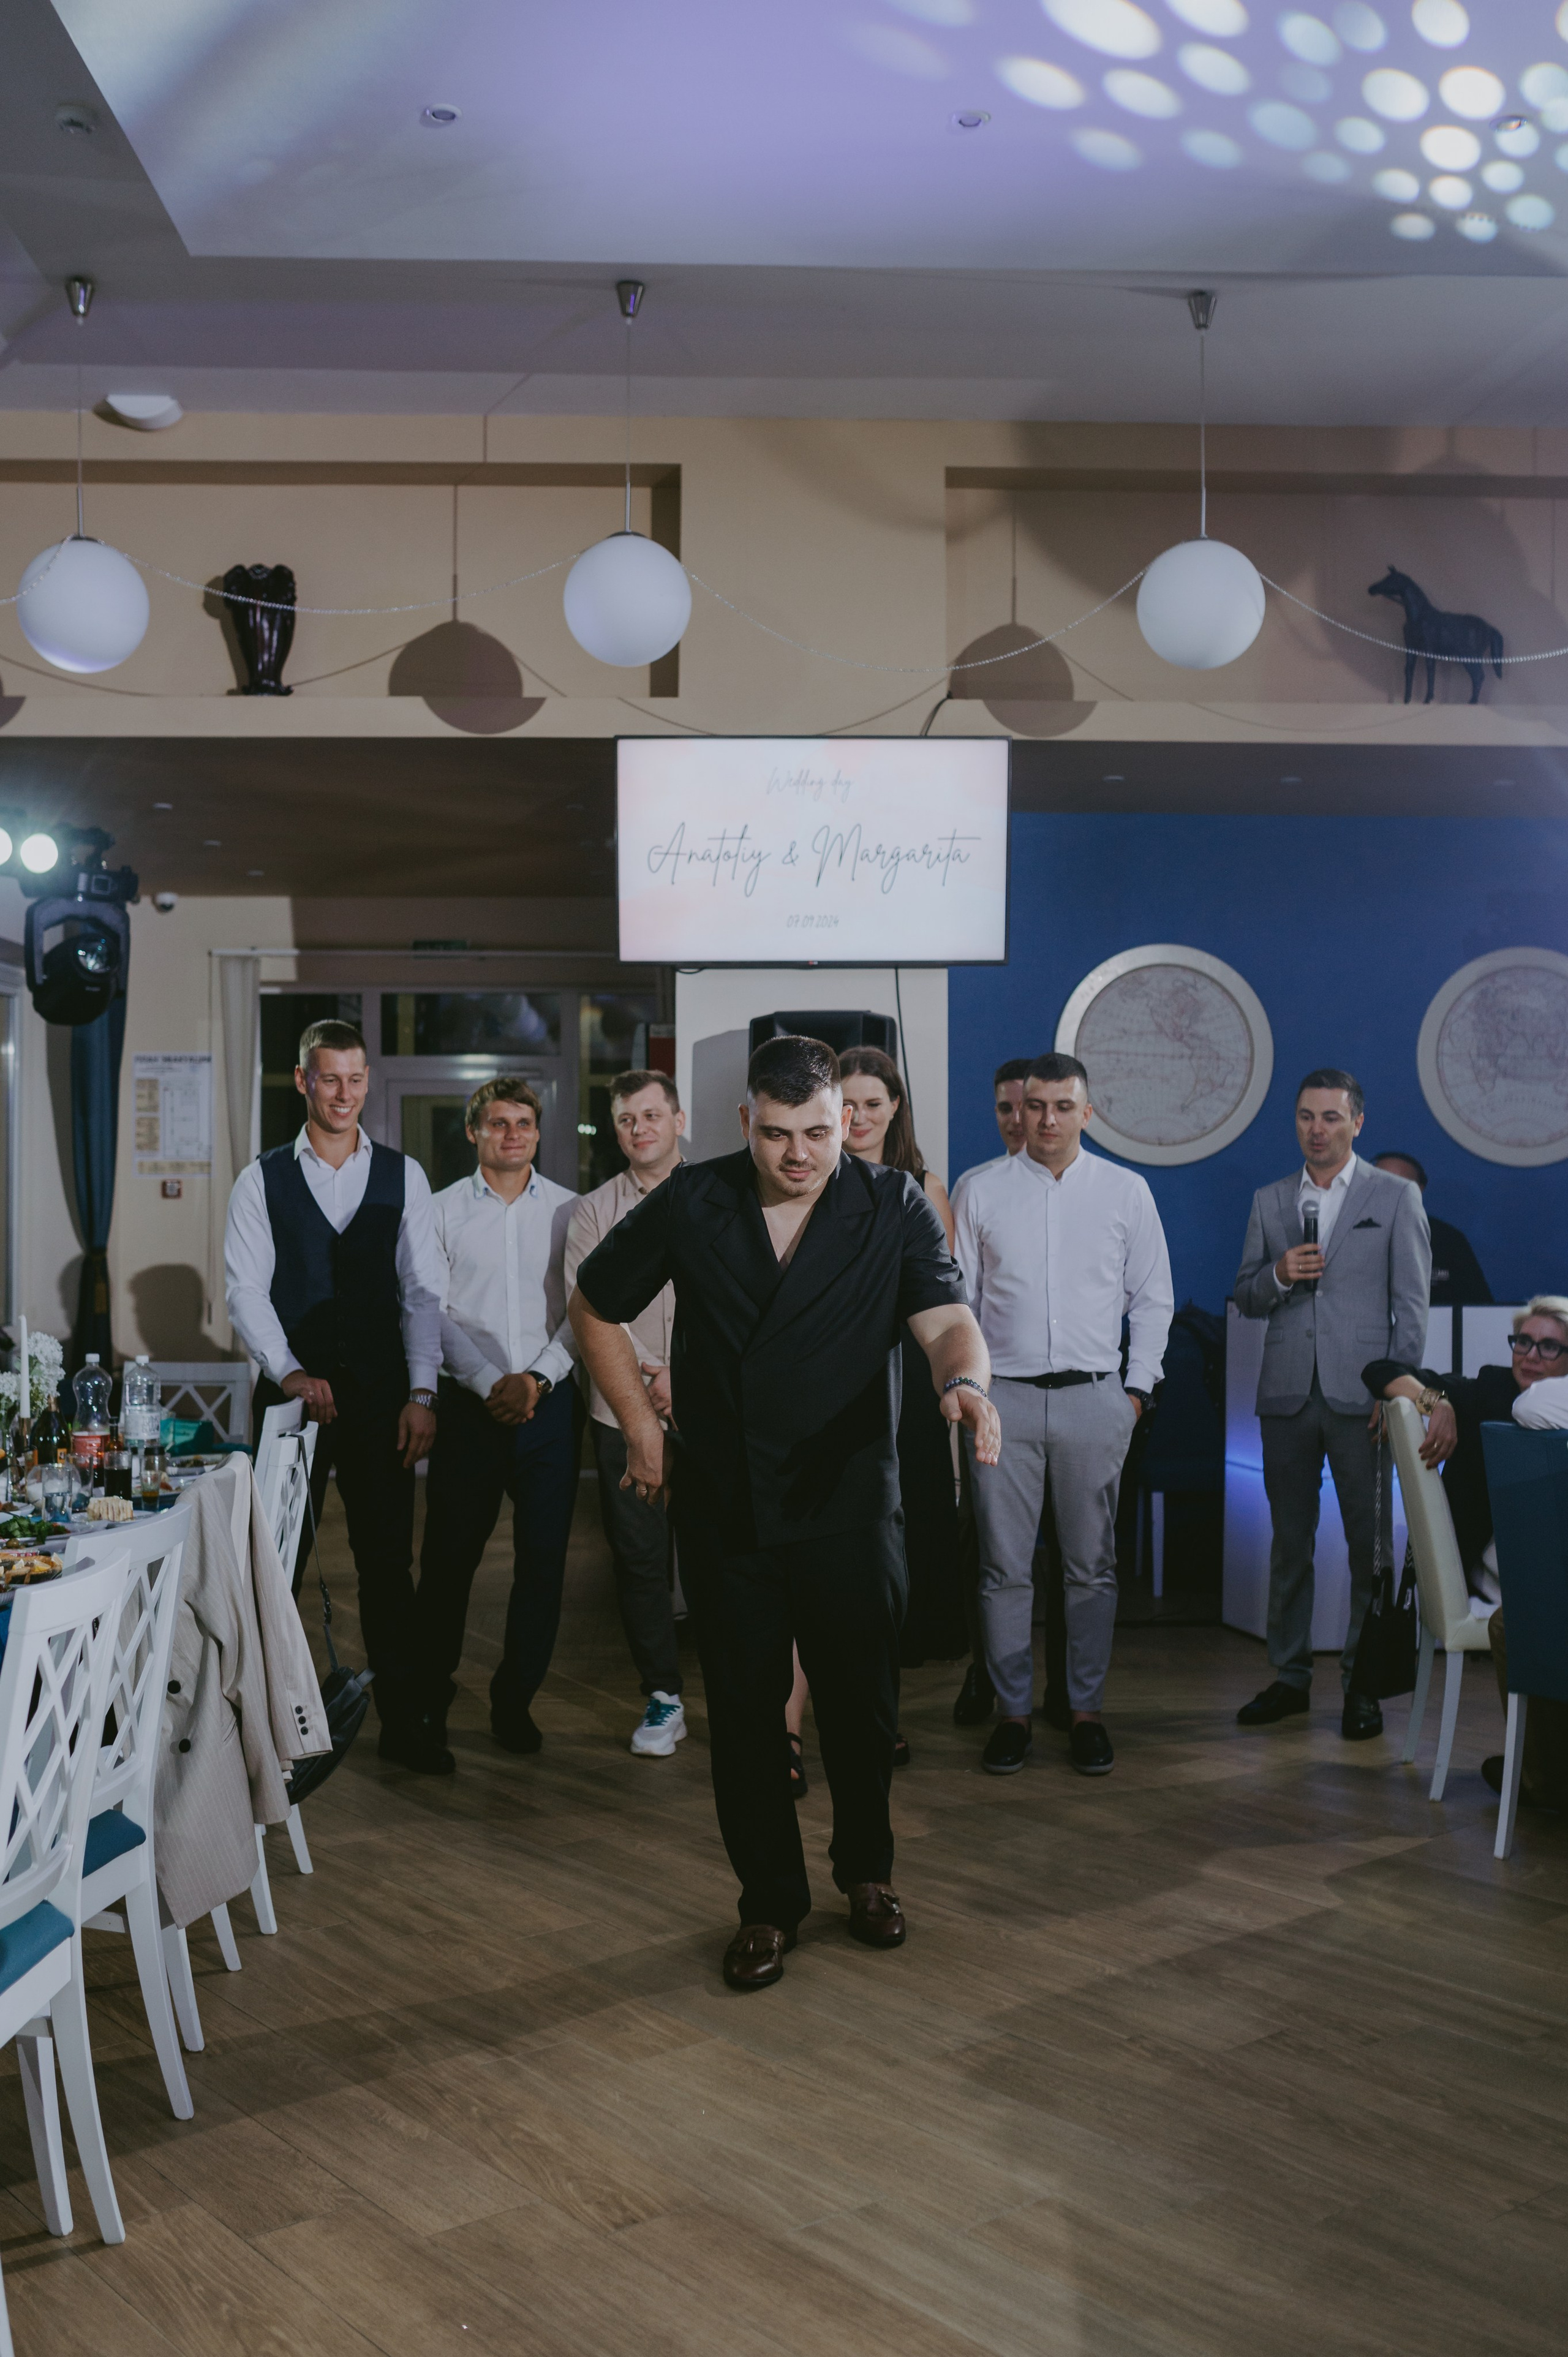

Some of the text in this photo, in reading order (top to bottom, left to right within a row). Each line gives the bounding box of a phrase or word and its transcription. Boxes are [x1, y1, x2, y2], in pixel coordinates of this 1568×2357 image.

[766, 767, 854, 804] Wedding day
[781, 840, 799, 866] &
[812, 823, 981, 894] Margarita
